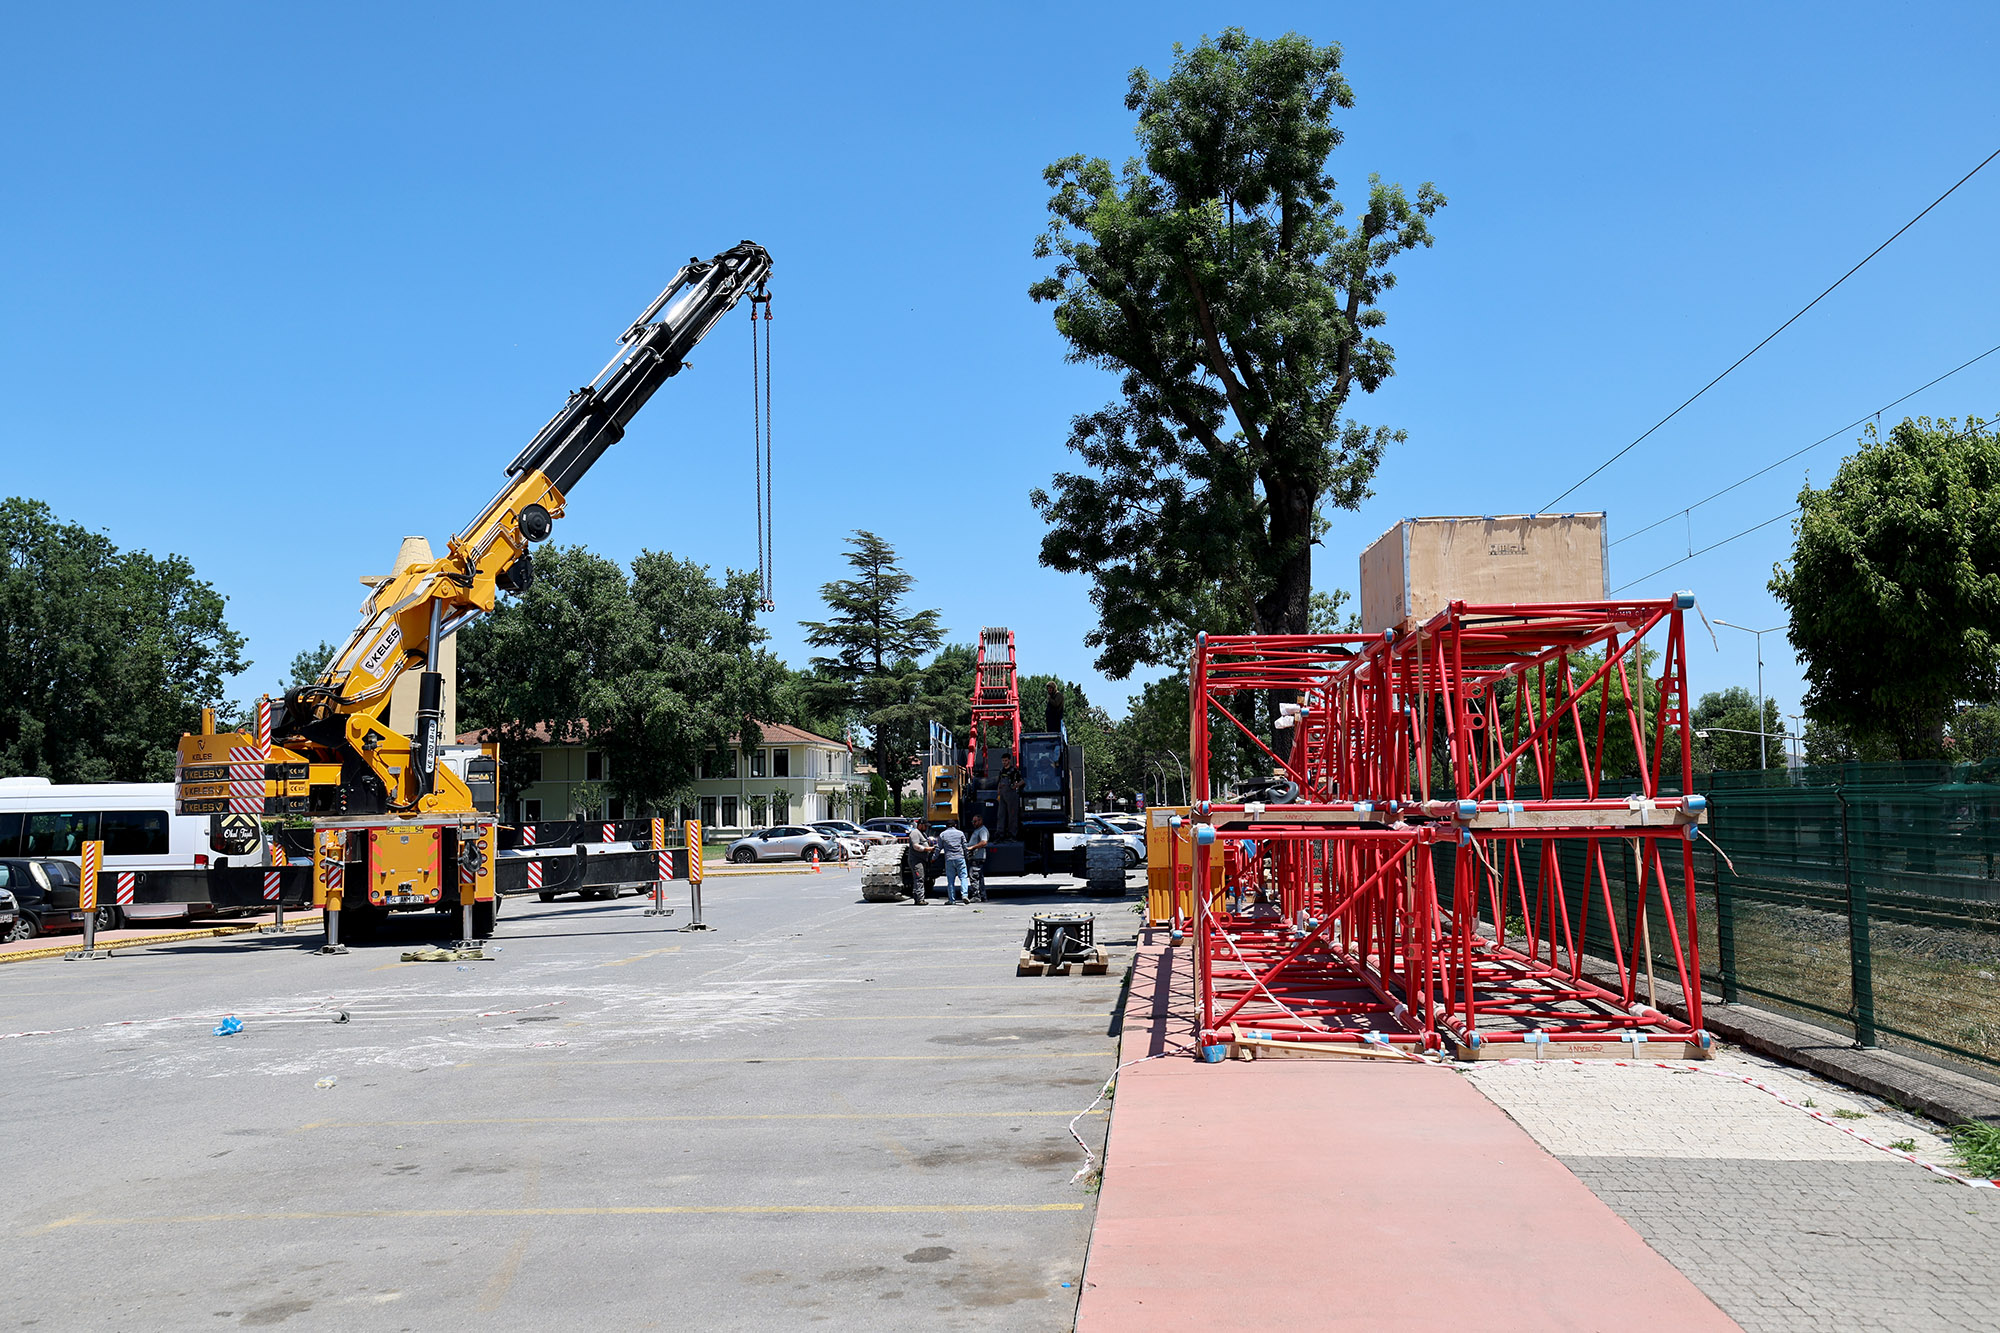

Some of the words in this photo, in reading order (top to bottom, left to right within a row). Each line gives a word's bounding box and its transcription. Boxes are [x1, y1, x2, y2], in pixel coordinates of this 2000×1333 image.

[372, 628, 400, 663] KELES
[190, 770, 215, 780] KELES
[189, 786, 215, 796] KELES
[189, 803, 215, 812] KELES
[1568, 1045, 1591, 1053] SANY
